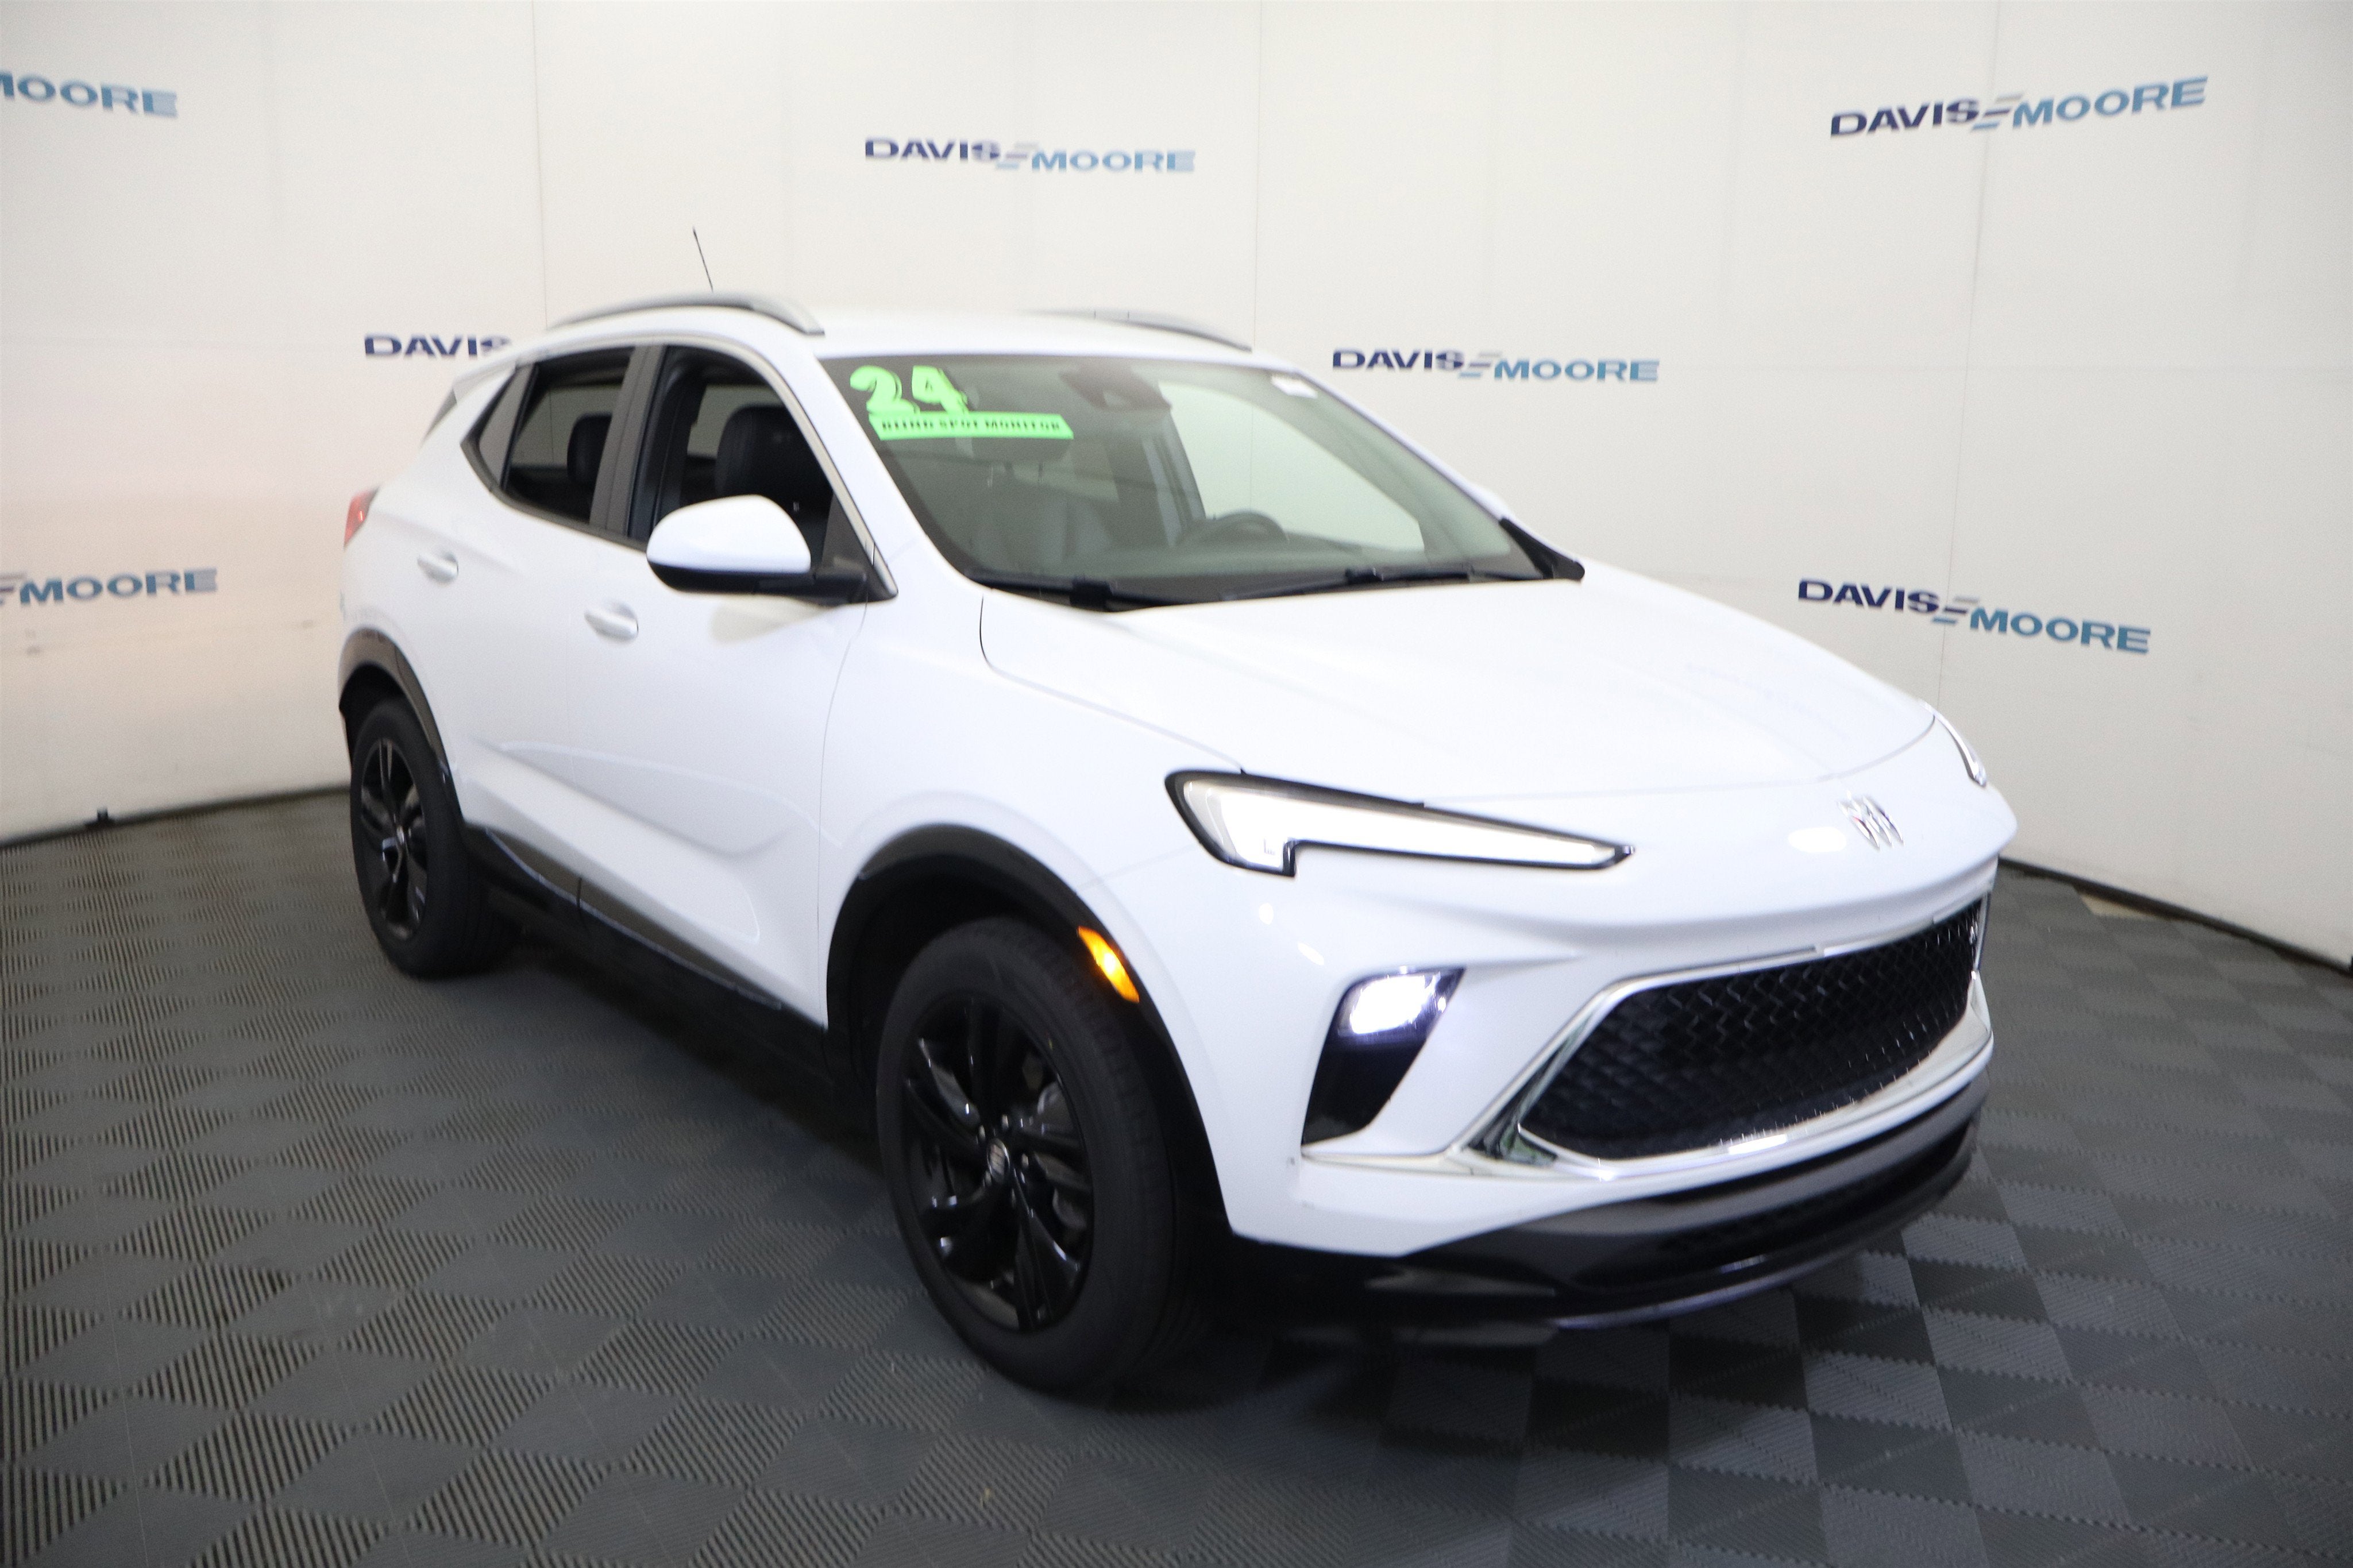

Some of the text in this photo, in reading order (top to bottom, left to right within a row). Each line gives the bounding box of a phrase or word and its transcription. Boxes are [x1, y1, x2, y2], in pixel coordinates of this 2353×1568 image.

[1831, 76, 2208, 137] DAVIS MOORE
[865, 137, 1195, 173] DAVIS MOORE
[1332, 349, 1660, 382] DAVIS MOORE
[850, 365, 970, 415] 24
[20, 567, 217, 607] MOORE
[1798, 578, 2151, 655] DAVIS MOORE
